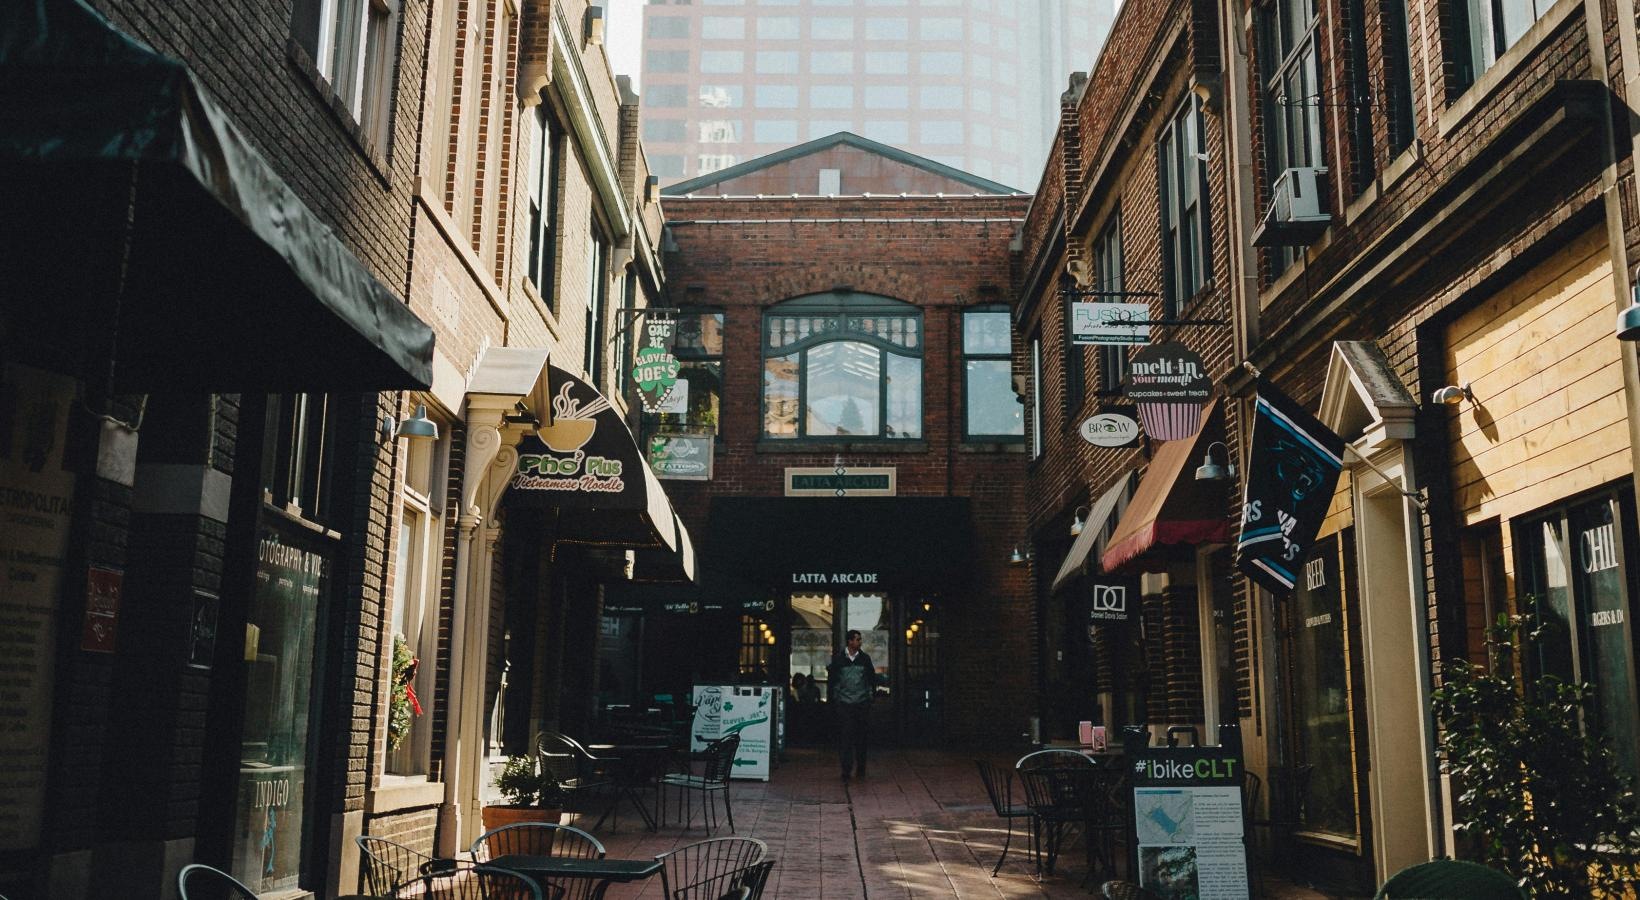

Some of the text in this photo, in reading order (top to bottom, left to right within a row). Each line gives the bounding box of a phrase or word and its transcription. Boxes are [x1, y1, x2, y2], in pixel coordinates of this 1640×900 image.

[1076, 308, 1147, 322] FUSION
[649, 337, 664, 348] AT
[635, 353, 675, 367] CLOVER
[634, 364, 678, 383] JOE'S
[1188, 390, 1208, 398] treats
[586, 456, 622, 476] Plus
[513, 475, 624, 492] Vietnamese Noodle
[794, 476, 886, 487] LATTA ARCADE
[259, 539, 302, 570] OTOGRAPHY
[304, 552, 309, 573] &
[792, 573, 878, 584] LATTA ARCADE
[1306, 557, 1326, 591] BEER
[1135, 759, 1236, 779] #ibikeCLT
[255, 779, 289, 808] INDIGO
